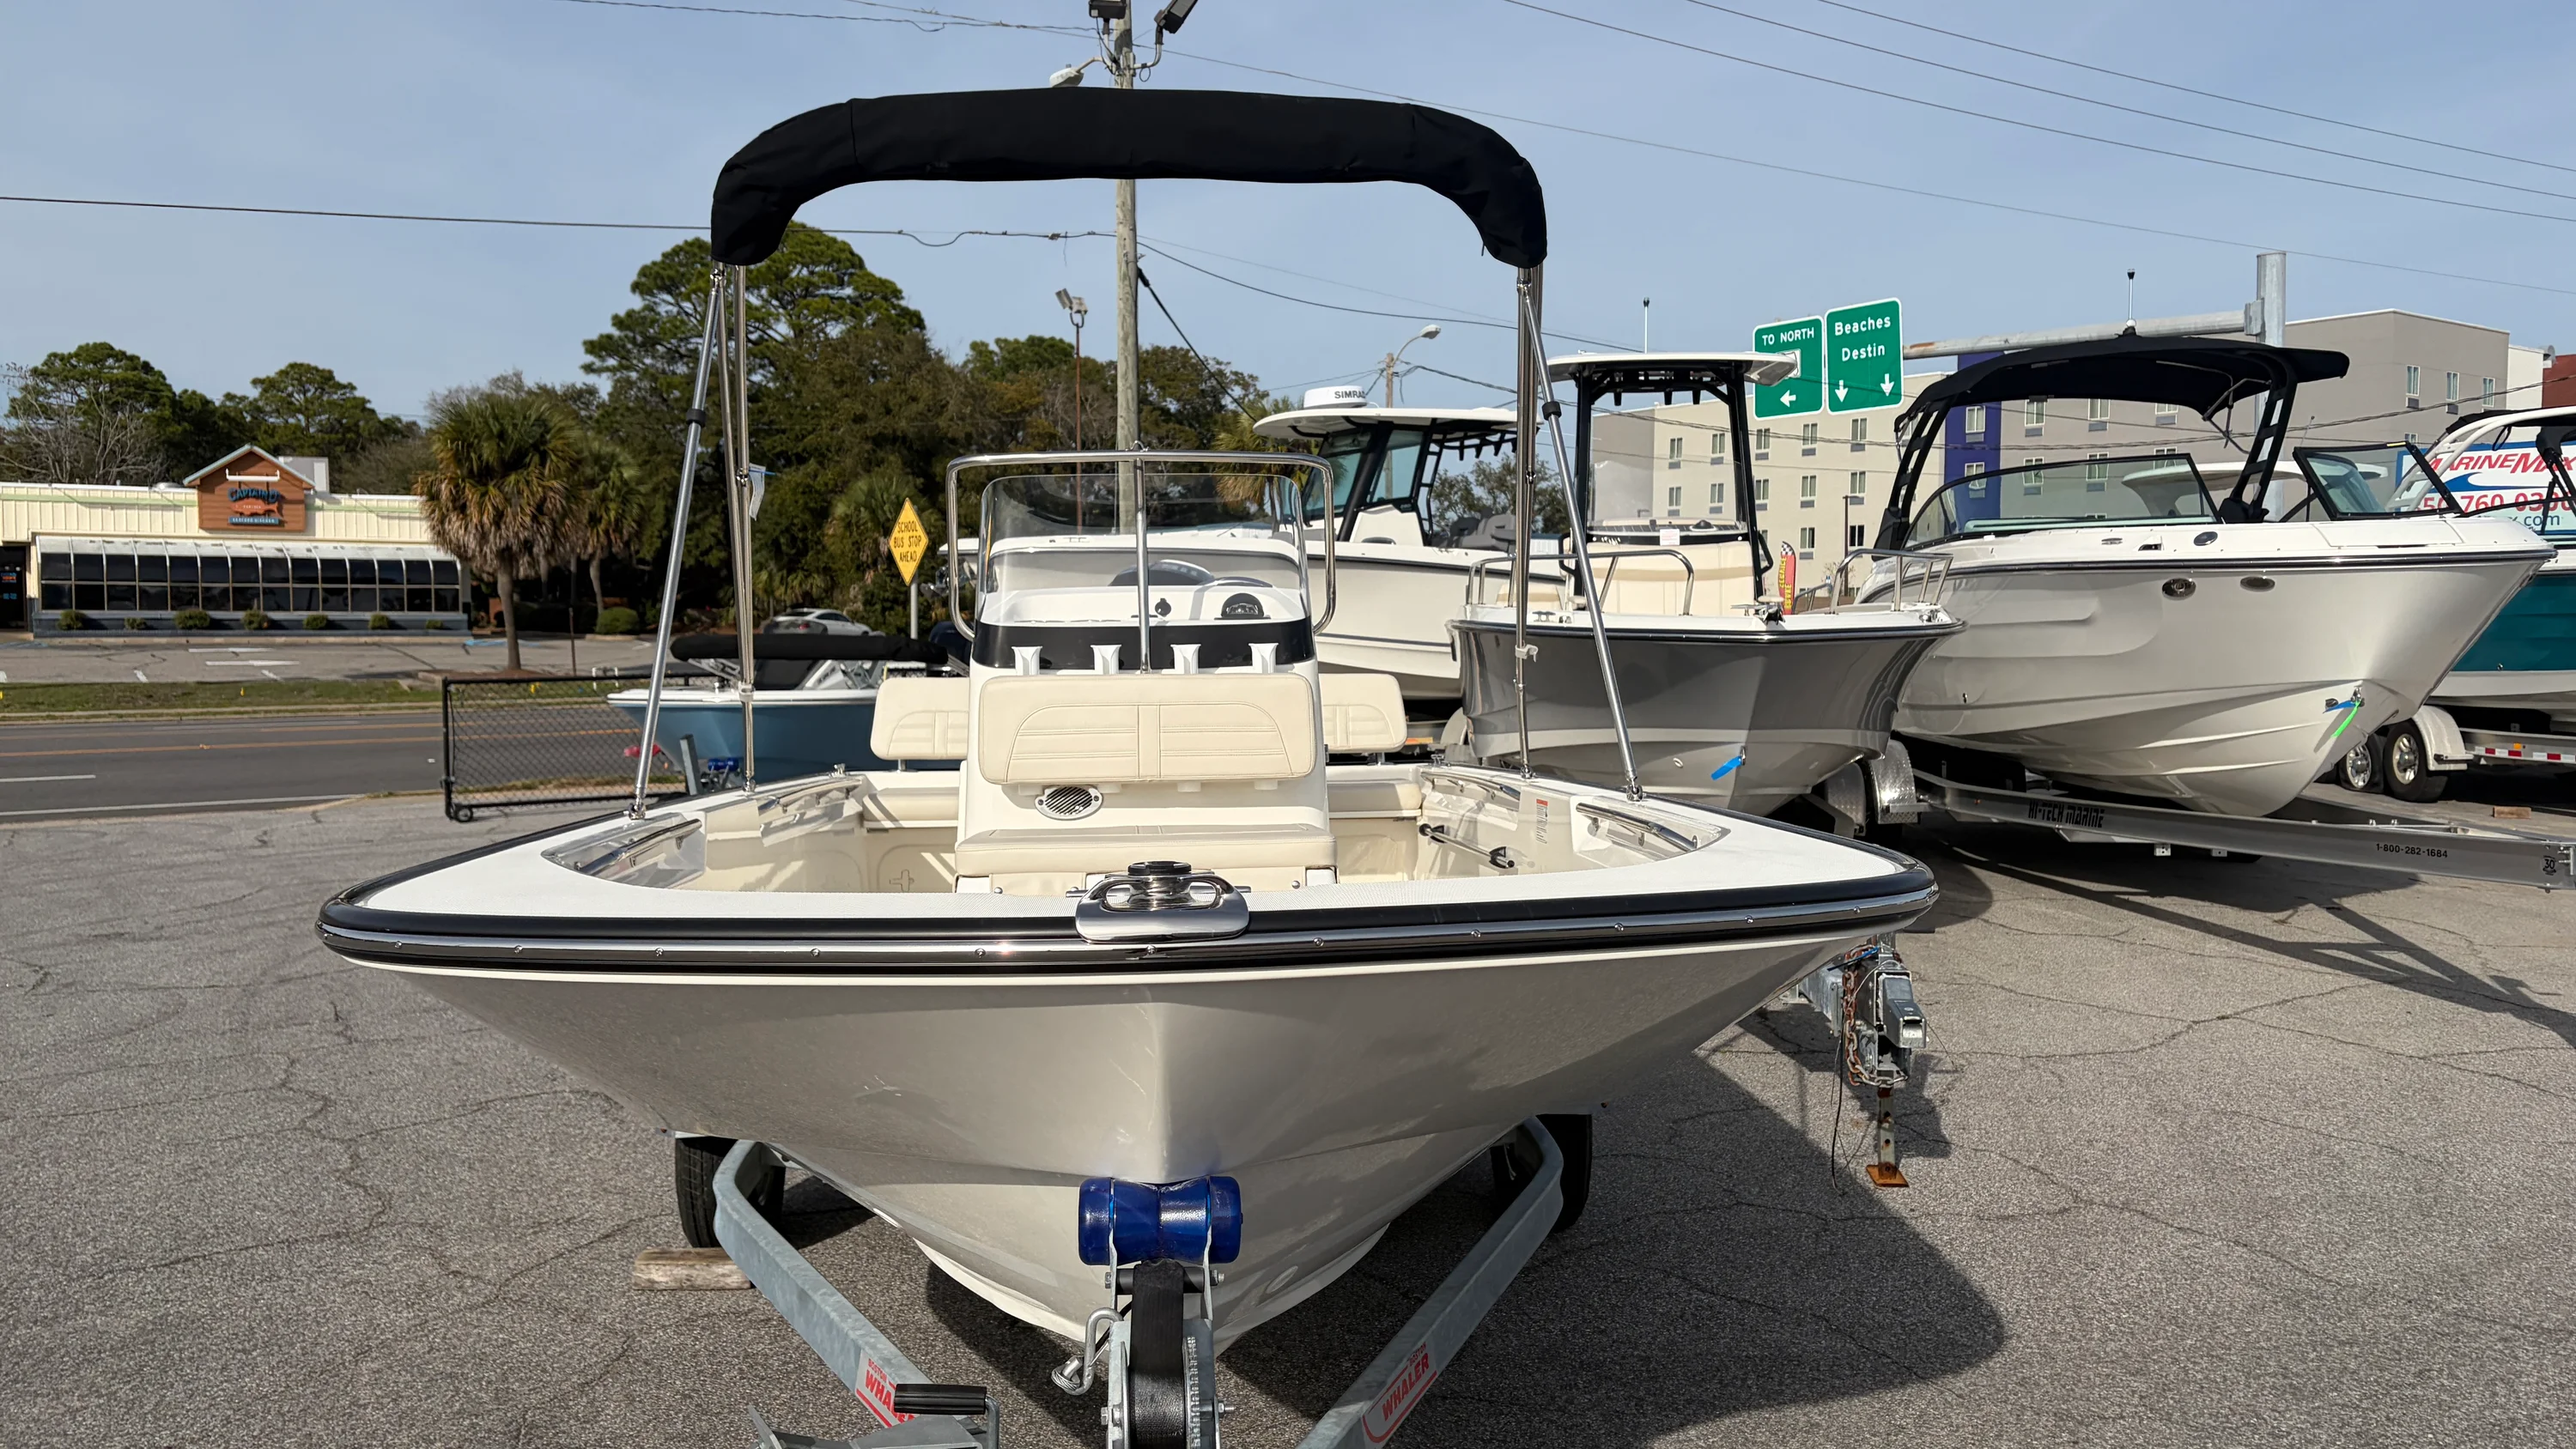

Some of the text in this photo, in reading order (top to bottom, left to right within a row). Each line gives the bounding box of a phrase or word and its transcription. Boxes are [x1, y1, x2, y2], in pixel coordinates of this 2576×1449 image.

[1834, 317, 1891, 336] Beaches
[1761, 327, 1815, 346] TO NORTH
[1842, 343, 1886, 361] Destin
[2429, 452, 2576, 474] RINEMX
[897, 520, 918, 533] SCHOOL
[894, 535, 921, 549] BUS STOP
[899, 550, 917, 562] AHEAD
[2065, 804, 2105, 828] MARINE
[2376, 843, 2448, 858] 1-800-282-1684
[2544, 858, 2555, 870] 30
[1382, 1352, 1430, 1422] WHALER
